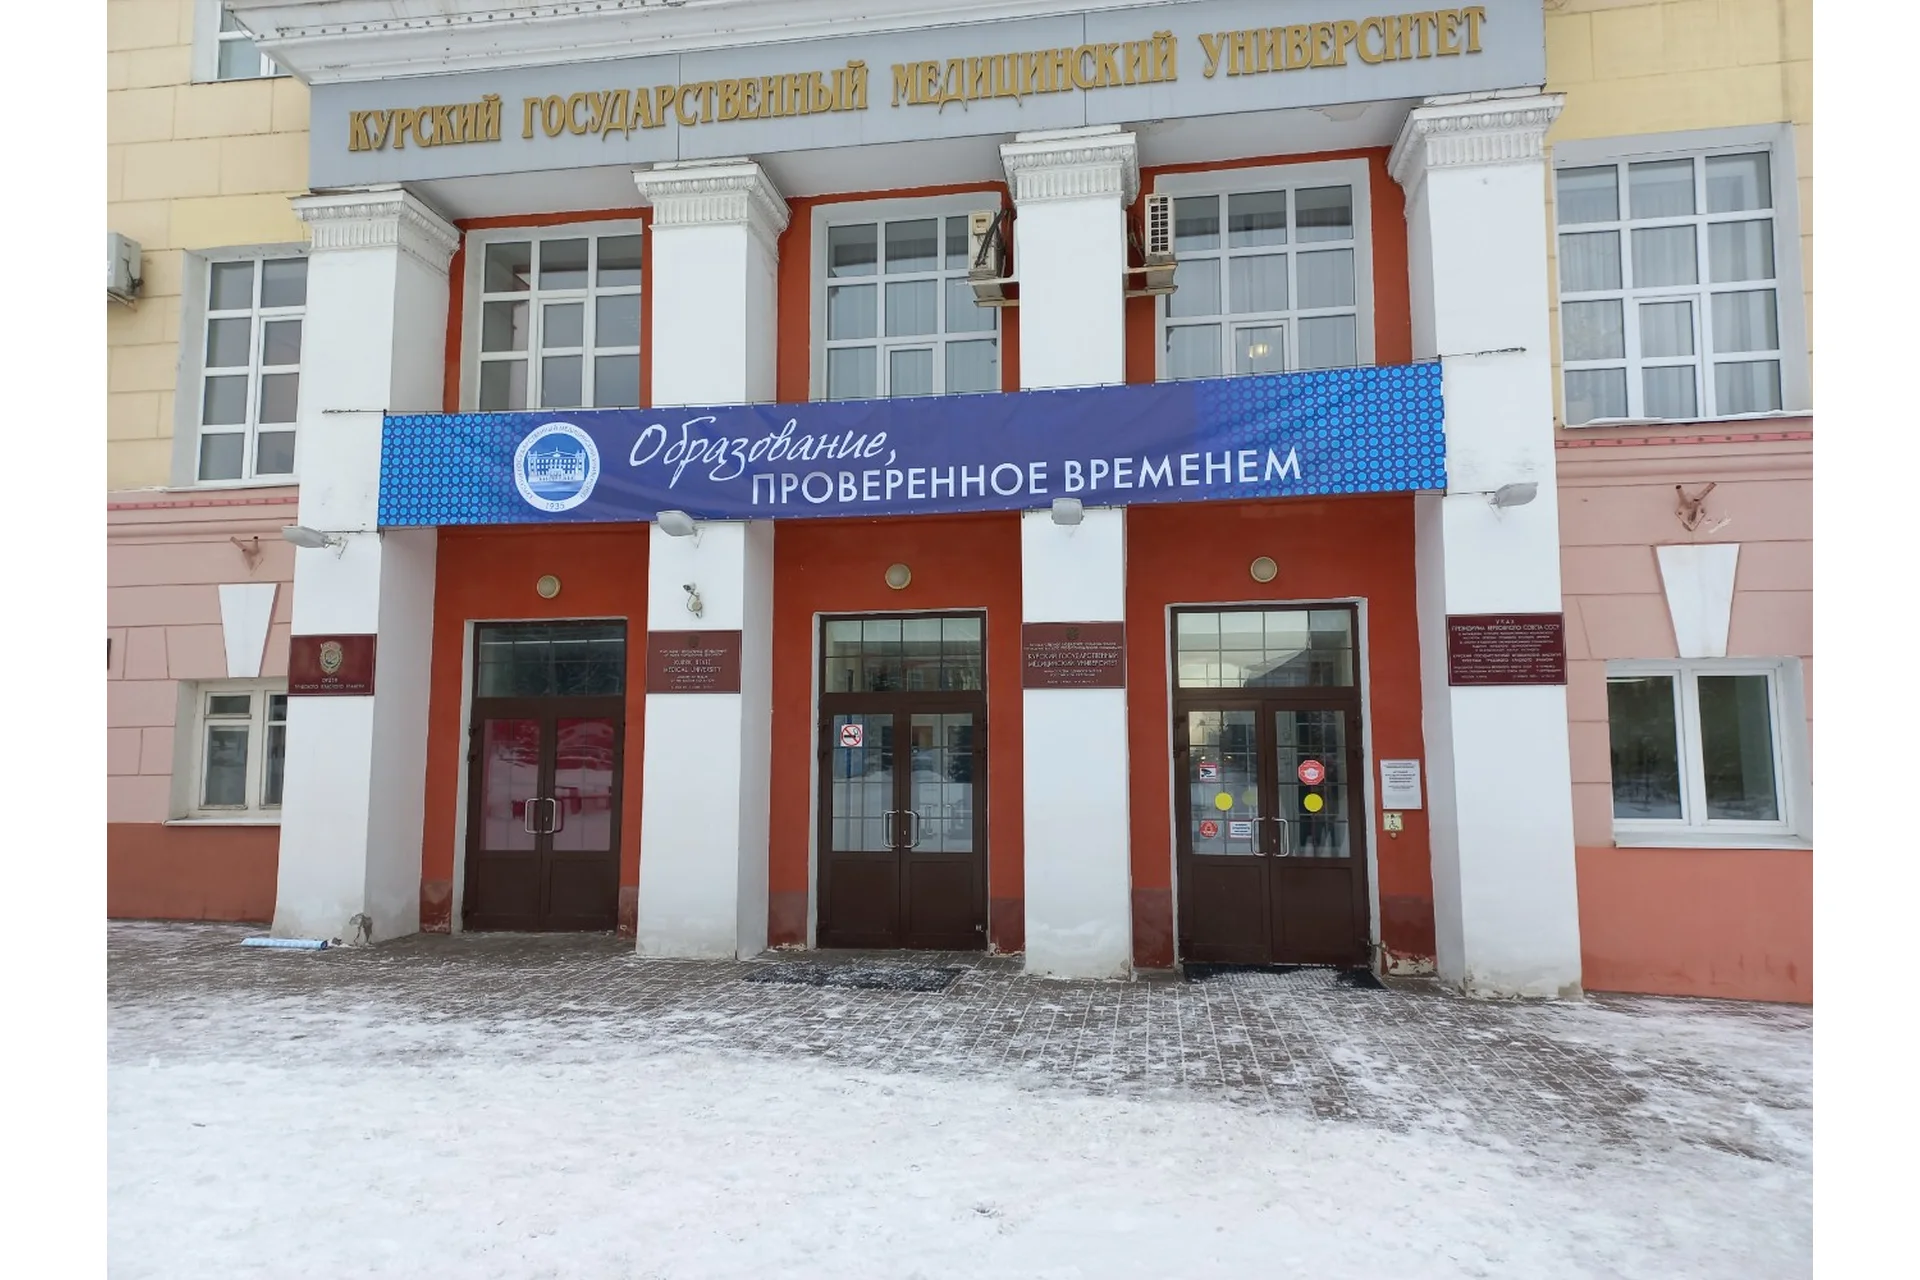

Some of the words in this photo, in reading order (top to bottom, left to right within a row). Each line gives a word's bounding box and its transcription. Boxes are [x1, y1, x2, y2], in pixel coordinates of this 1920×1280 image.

[348, 93, 503, 152] КУРСКИЙ
[521, 60, 870, 142] ГОСУДАРСТВЕННЫЙ
[890, 30, 1179, 115] МЕДИЦИНСКИЙ
[1199, 6, 1487, 79] УНИВЕРСИТЕТ
[628, 414, 898, 489] Образование,
[751, 460, 1048, 505] ПРОВЕРЕННОЕ
[1063, 446, 1302, 493] ВРЕМЕНЕМ
[545, 502, 565, 510] 1935
